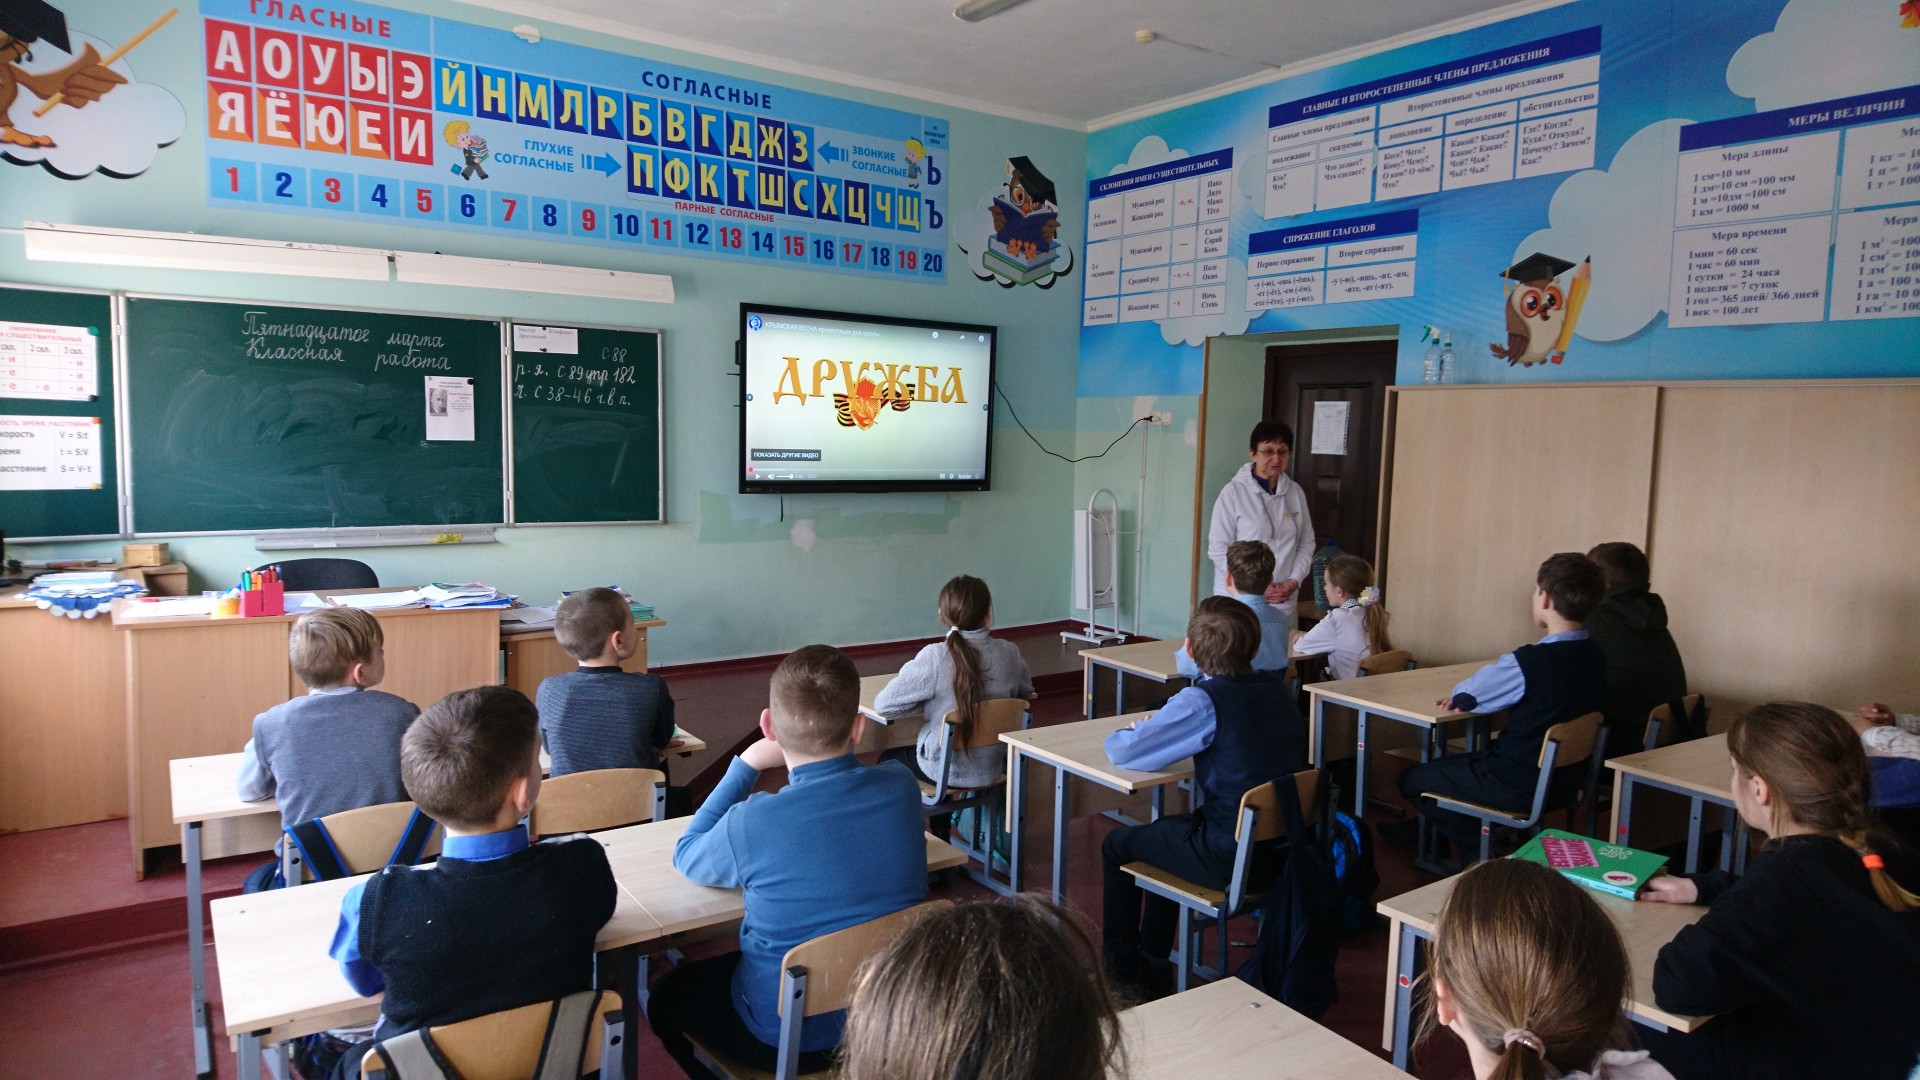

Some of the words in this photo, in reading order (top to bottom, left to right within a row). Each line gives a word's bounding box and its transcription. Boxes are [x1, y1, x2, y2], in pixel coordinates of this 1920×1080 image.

[250, 0, 392, 38] ГЛАСНЫЕ
[214, 30, 244, 74] А
[263, 38, 292, 79] О
[309, 44, 337, 85] У
[351, 52, 387, 95] Ы
[401, 60, 423, 99] Э
[1303, 98, 1340, 114] ГЛАВНЫЕ
[1341, 96, 1348, 105] И
[1350, 75, 1432, 103] ВТОРОСТЕПЕННЫЕ
[1434, 66, 1469, 82] ЧЛЕНЫ
[1471, 47, 1549, 74] ПРЕДЛОЖЕНИЯ
[642, 70, 772, 109] СОГЛАСНЫЕ
[1408, 93, 1473, 112] Второстепенные
[1475, 86, 1502, 98] члены
[1505, 73, 1564, 92] предложения
[1523, 93, 1594, 112] обстоятельство
[442, 62, 466, 107] Й
[483, 74, 506, 114] Н
[518, 81, 549, 121] М
[559, 90, 583, 127] Л
[597, 95, 618, 131] Р
[632, 102, 653, 137] Б
[667, 108, 686, 143] В
[700, 115, 717, 148] Г
[729, 120, 752, 159] Д
[759, 124, 784, 160] Ж
[792, 130, 808, 163] З
[1455, 110, 1507, 126] определение
[1788, 112, 1829, 128] МЕРЫ
[1833, 99, 1905, 120] ВЕЛИЧИН
[217, 91, 246, 134] Я
[266, 91, 292, 139] Ё
[305, 103, 344, 145] Ю
[359, 111, 382, 150] Е
[401, 117, 426, 157] И
[1273, 132, 1300, 142] Главные
[1302, 126, 1322, 136] члены
[1325, 115, 1369, 131] предложения
[1523, 124, 1541, 134] Где?
[1544, 118, 1573, 130] Когда?
[1388, 126, 1432, 140] дополнение
[1523, 134, 1546, 145] Куда?
[1549, 127, 1584, 139] Откуда?
[524, 140, 574, 157] ГЛУХИЕ
[1329, 140, 1363, 152] сказуемое
[1561, 137, 1591, 148] Зачем?
[852, 145, 896, 162] ЗВОНКИЕ
[1521, 156, 1542, 166] Как?
[1721, 152, 1749, 162] Мера
[1751, 147, 1788, 158] длины
[494, 152, 574, 173] СОГЛАСНЫЕ
[852, 160, 908, 178] СОГЛАСНЫЕ
[1100, 178, 1133, 191] СКЛОНЕНИЯ
[1135, 173, 1152, 184] ИМЕН
[1153, 158, 1219, 179] СУЩЕСТВИТЕЛЬНЫХ
[633, 152, 655, 187] П
[664, 157, 690, 194] Ф
[700, 164, 720, 198] К
[732, 168, 750, 201] Т
[759, 172, 784, 208] Ш
[793, 179, 809, 212] С
[821, 182, 838, 215] Х
[848, 186, 868, 226] Ц
[875, 191, 891, 222] Ч
[898, 194, 920, 231] Щ
[1207, 198, 1223, 206] Мама
[1726, 203, 1748, 213] 1000
[226, 167, 239, 192] 1
[275, 172, 292, 198] 2
[324, 178, 341, 203] 3
[371, 184, 388, 208] 4
[417, 188, 432, 213] 5
[460, 194, 475, 218] 6
[503, 199, 517, 222] 7
[543, 204, 557, 227] 8
[582, 208, 595, 231] 9
[614, 213, 639, 237] 10
[650, 218, 673, 241] 11
[685, 222, 709, 245] 12
[720, 226, 742, 249] 13
[752, 230, 774, 253] 14
[784, 235, 805, 257] 15
[814, 239, 834, 260] 16
[843, 242, 863, 264] 17
[871, 246, 890, 267] 18
[899, 249, 917, 270] 19
[924, 253, 942, 273] 20
[675, 201, 716, 215] ПАРНЫЕ
[720, 208, 775, 223] СОГЛАСНЫЕ
[1883, 216, 1918, 228] Мера
[1204, 236, 1222, 245] Сарай
[1283, 230, 1331, 244] СПРЯЖЕНИЕ
[1332, 223, 1376, 237] ГЛАГОЛОВ
[1712, 231, 1738, 241] Мера
[1741, 227, 1787, 239] времени
[1339, 249, 1363, 258] Второе
[1364, 244, 1405, 256] спряжение
[1726, 247, 1738, 255] 60
[1257, 259, 1279, 269] Первое
[1280, 255, 1315, 267] спряжение
[1724, 259, 1736, 267] 60
[1695, 273, 1723, 283] сутки
[1741, 270, 1753, 278] 24
[1694, 285, 1728, 293] неделя
[1749, 282, 1779, 291] суток
[1721, 294, 1739, 304] 365
[1771, 291, 1790, 300] 366
[1792, 290, 1819, 300] дней
[1723, 306, 1739, 315] 100
[241, 311, 370, 344] Пятнадцатое
[386, 332, 444, 351] марта
[245, 338, 345, 363] Классная
[374, 349, 451, 371] работа
[613, 365, 636, 384] 182
[773, 356, 967, 406] ДРУЖБА
[753, 451, 781, 459] ПОКАЗАТЬ
[781, 451, 801, 460] ДРУГИЕ
